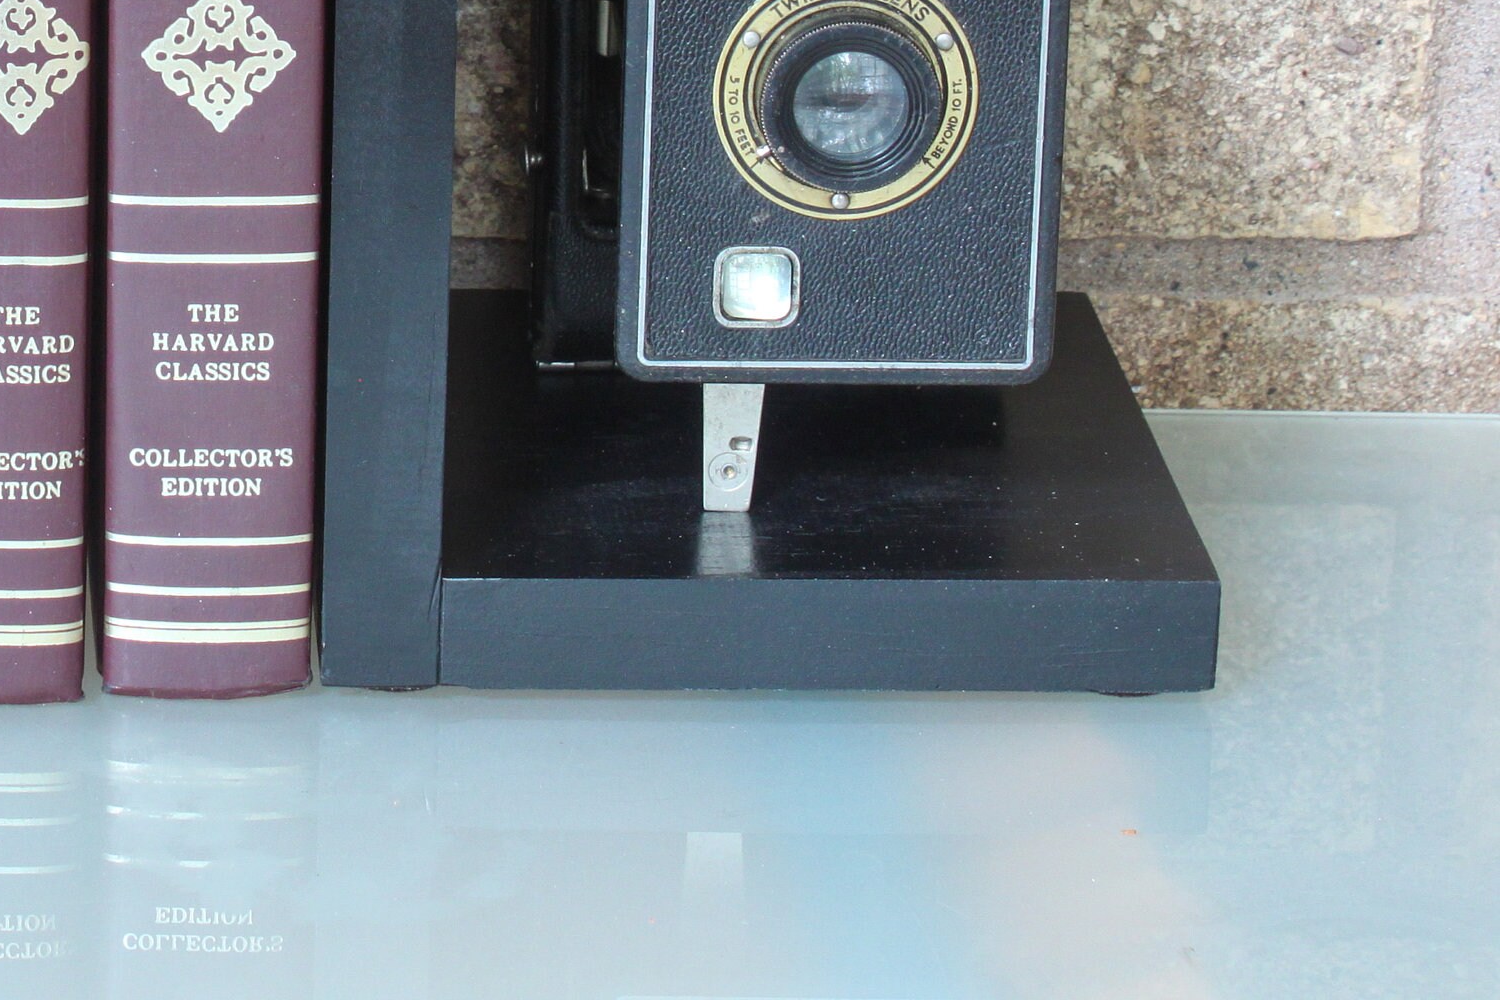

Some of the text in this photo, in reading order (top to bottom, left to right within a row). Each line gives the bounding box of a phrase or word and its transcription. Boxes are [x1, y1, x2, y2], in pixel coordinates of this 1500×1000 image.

[728, 88, 739, 106] TO
[729, 110, 740, 125] 10
[930, 78, 963, 160] BEYOND 10 FT.
[734, 128, 755, 156] FEET
[187, 303, 240, 323] THE
[152, 332, 275, 352] HARVARD
[155, 361, 271, 382] CLASSICS
[128, 447, 294, 468] COLLECTOR'S
[160, 477, 262, 497] EDITION
